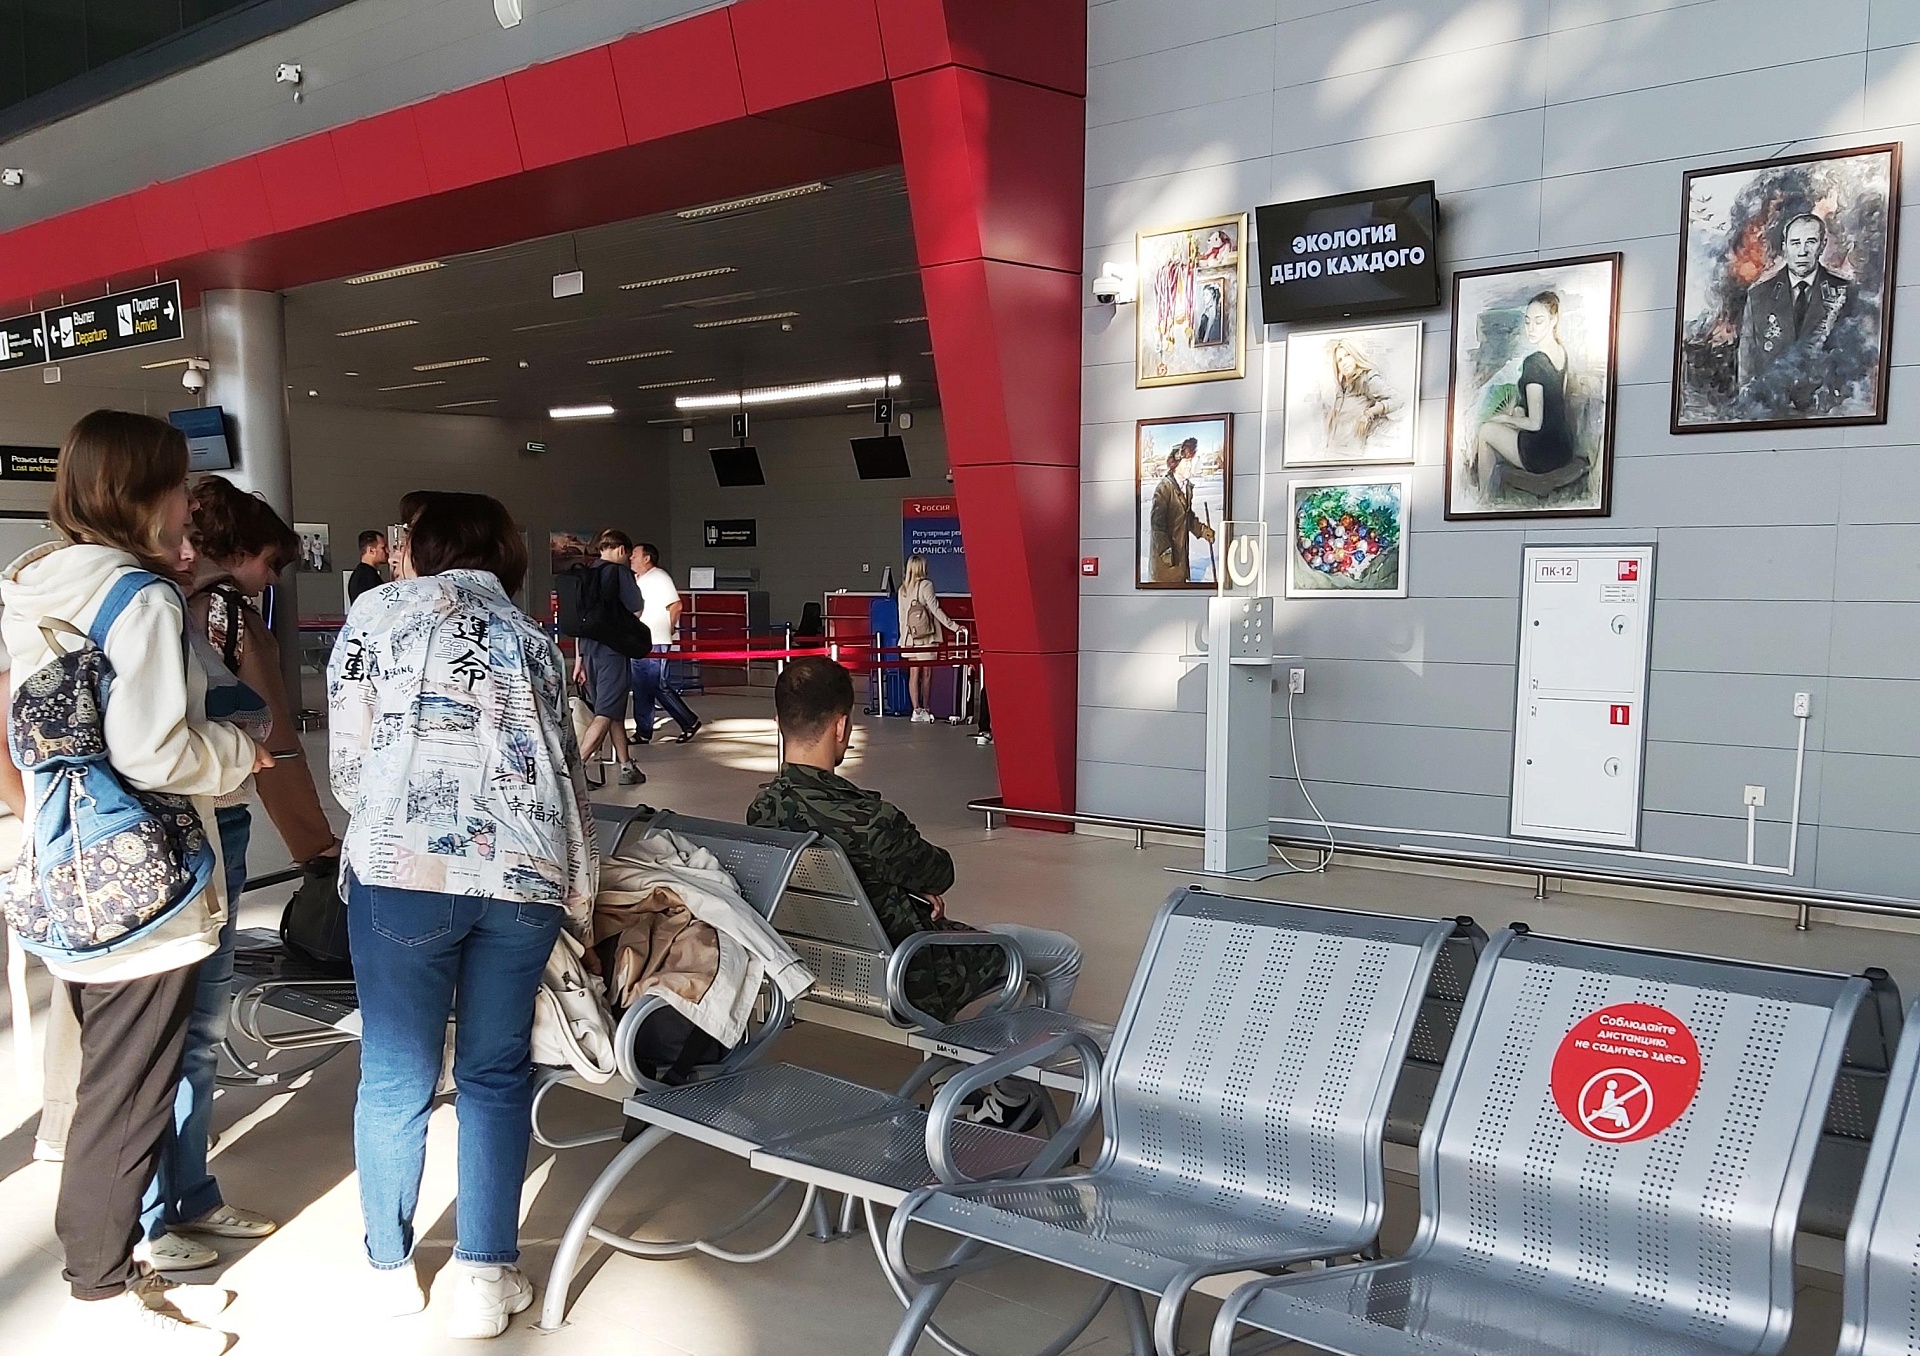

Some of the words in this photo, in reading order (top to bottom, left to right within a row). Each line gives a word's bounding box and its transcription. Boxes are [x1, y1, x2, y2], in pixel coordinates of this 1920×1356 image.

[1291, 223, 1397, 255] ЭКОЛОГИЯ
[1270, 260, 1322, 285] ДЕЛО
[1326, 247, 1425, 276] КАЖДОГО
[132, 297, 160, 315] Прилет
[72, 311, 95, 326] Вылет
[135, 315, 158, 334] Arrival
[74, 328, 108, 347] Departure
[880, 404, 888, 418] 2
[735, 419, 742, 433] 1
[11, 464, 28, 472] Lost
[28, 465, 43, 473] and
[922, 504, 950, 512] РОССИЯ
[1541, 565, 1573, 577] ПК-12
[1599, 1014, 1677, 1035] Соблюдайте
[1597, 1030, 1669, 1048] дистанцию,
[1574, 1039, 1590, 1049] не
[1592, 1043, 1649, 1060] садитесь
[1651, 1051, 1687, 1065] здесь
